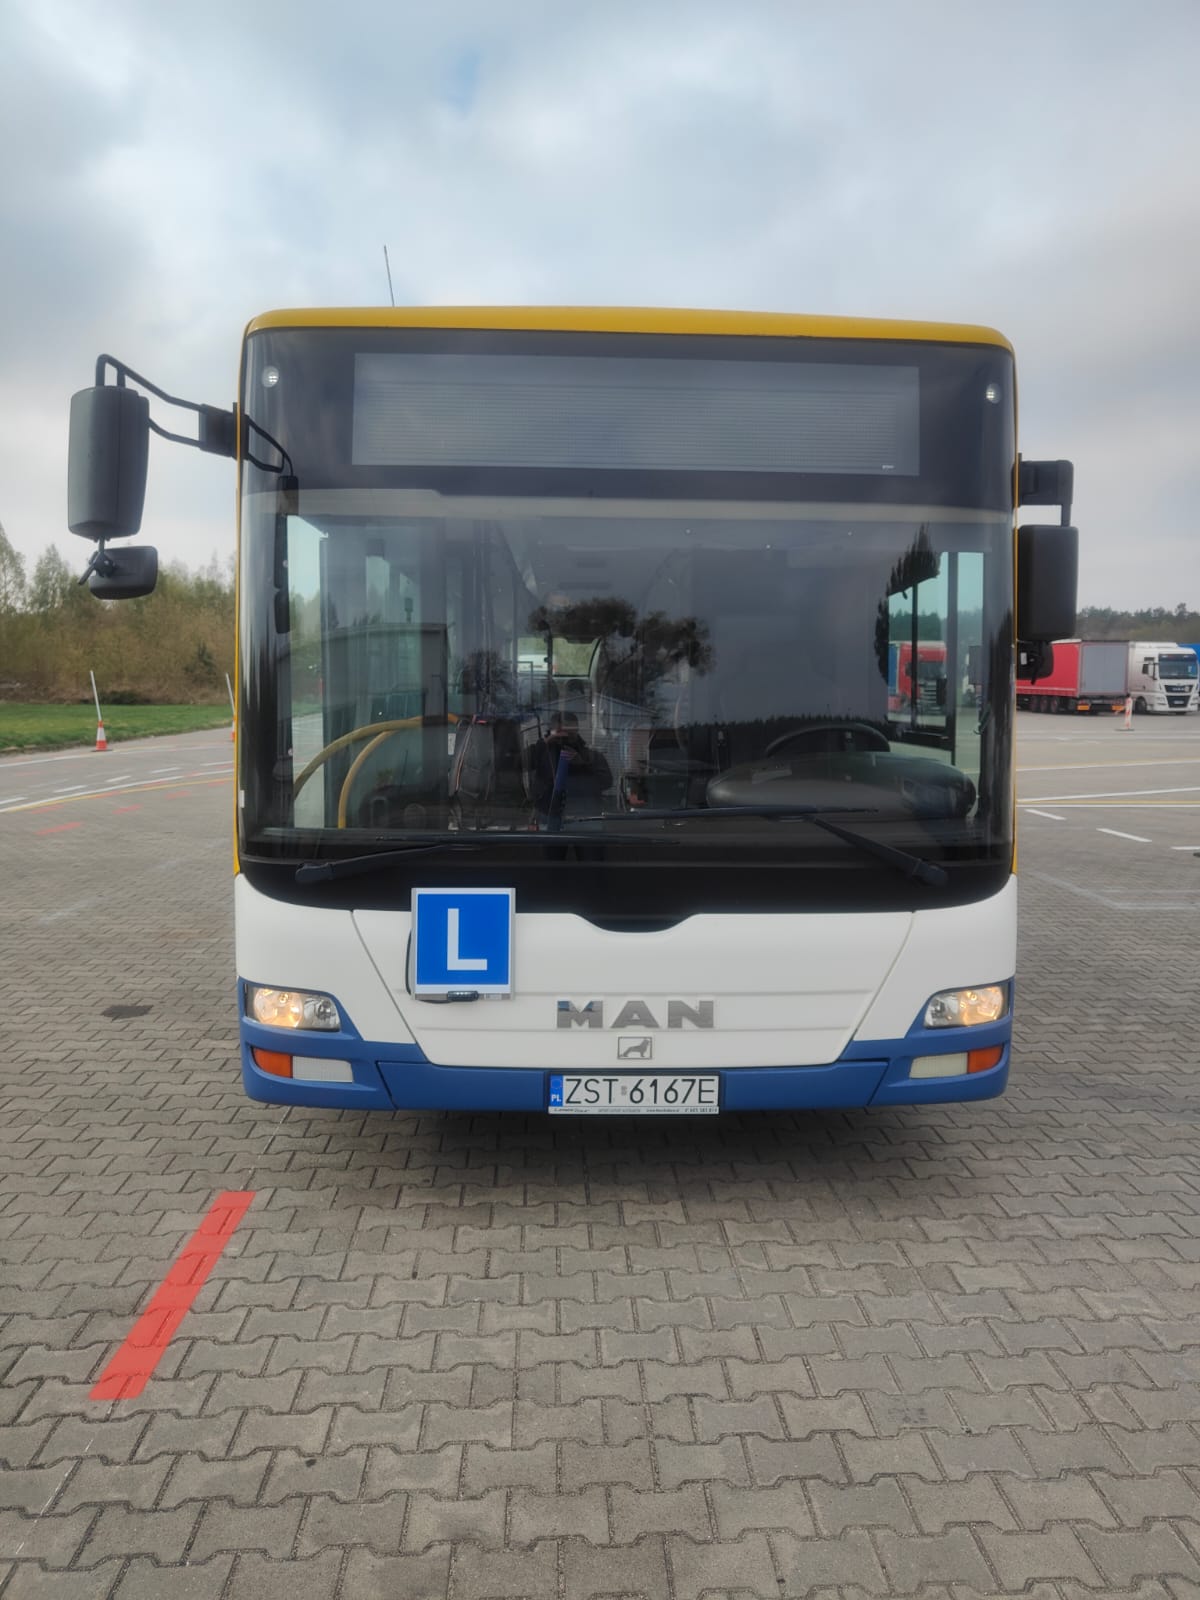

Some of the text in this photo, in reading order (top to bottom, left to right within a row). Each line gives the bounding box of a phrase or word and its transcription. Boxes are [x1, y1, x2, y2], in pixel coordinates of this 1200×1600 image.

[447, 908, 488, 971] L
[556, 1000, 714, 1029] MAN
[551, 1094, 562, 1102] PL
[565, 1078, 715, 1104] ZST 6167E
